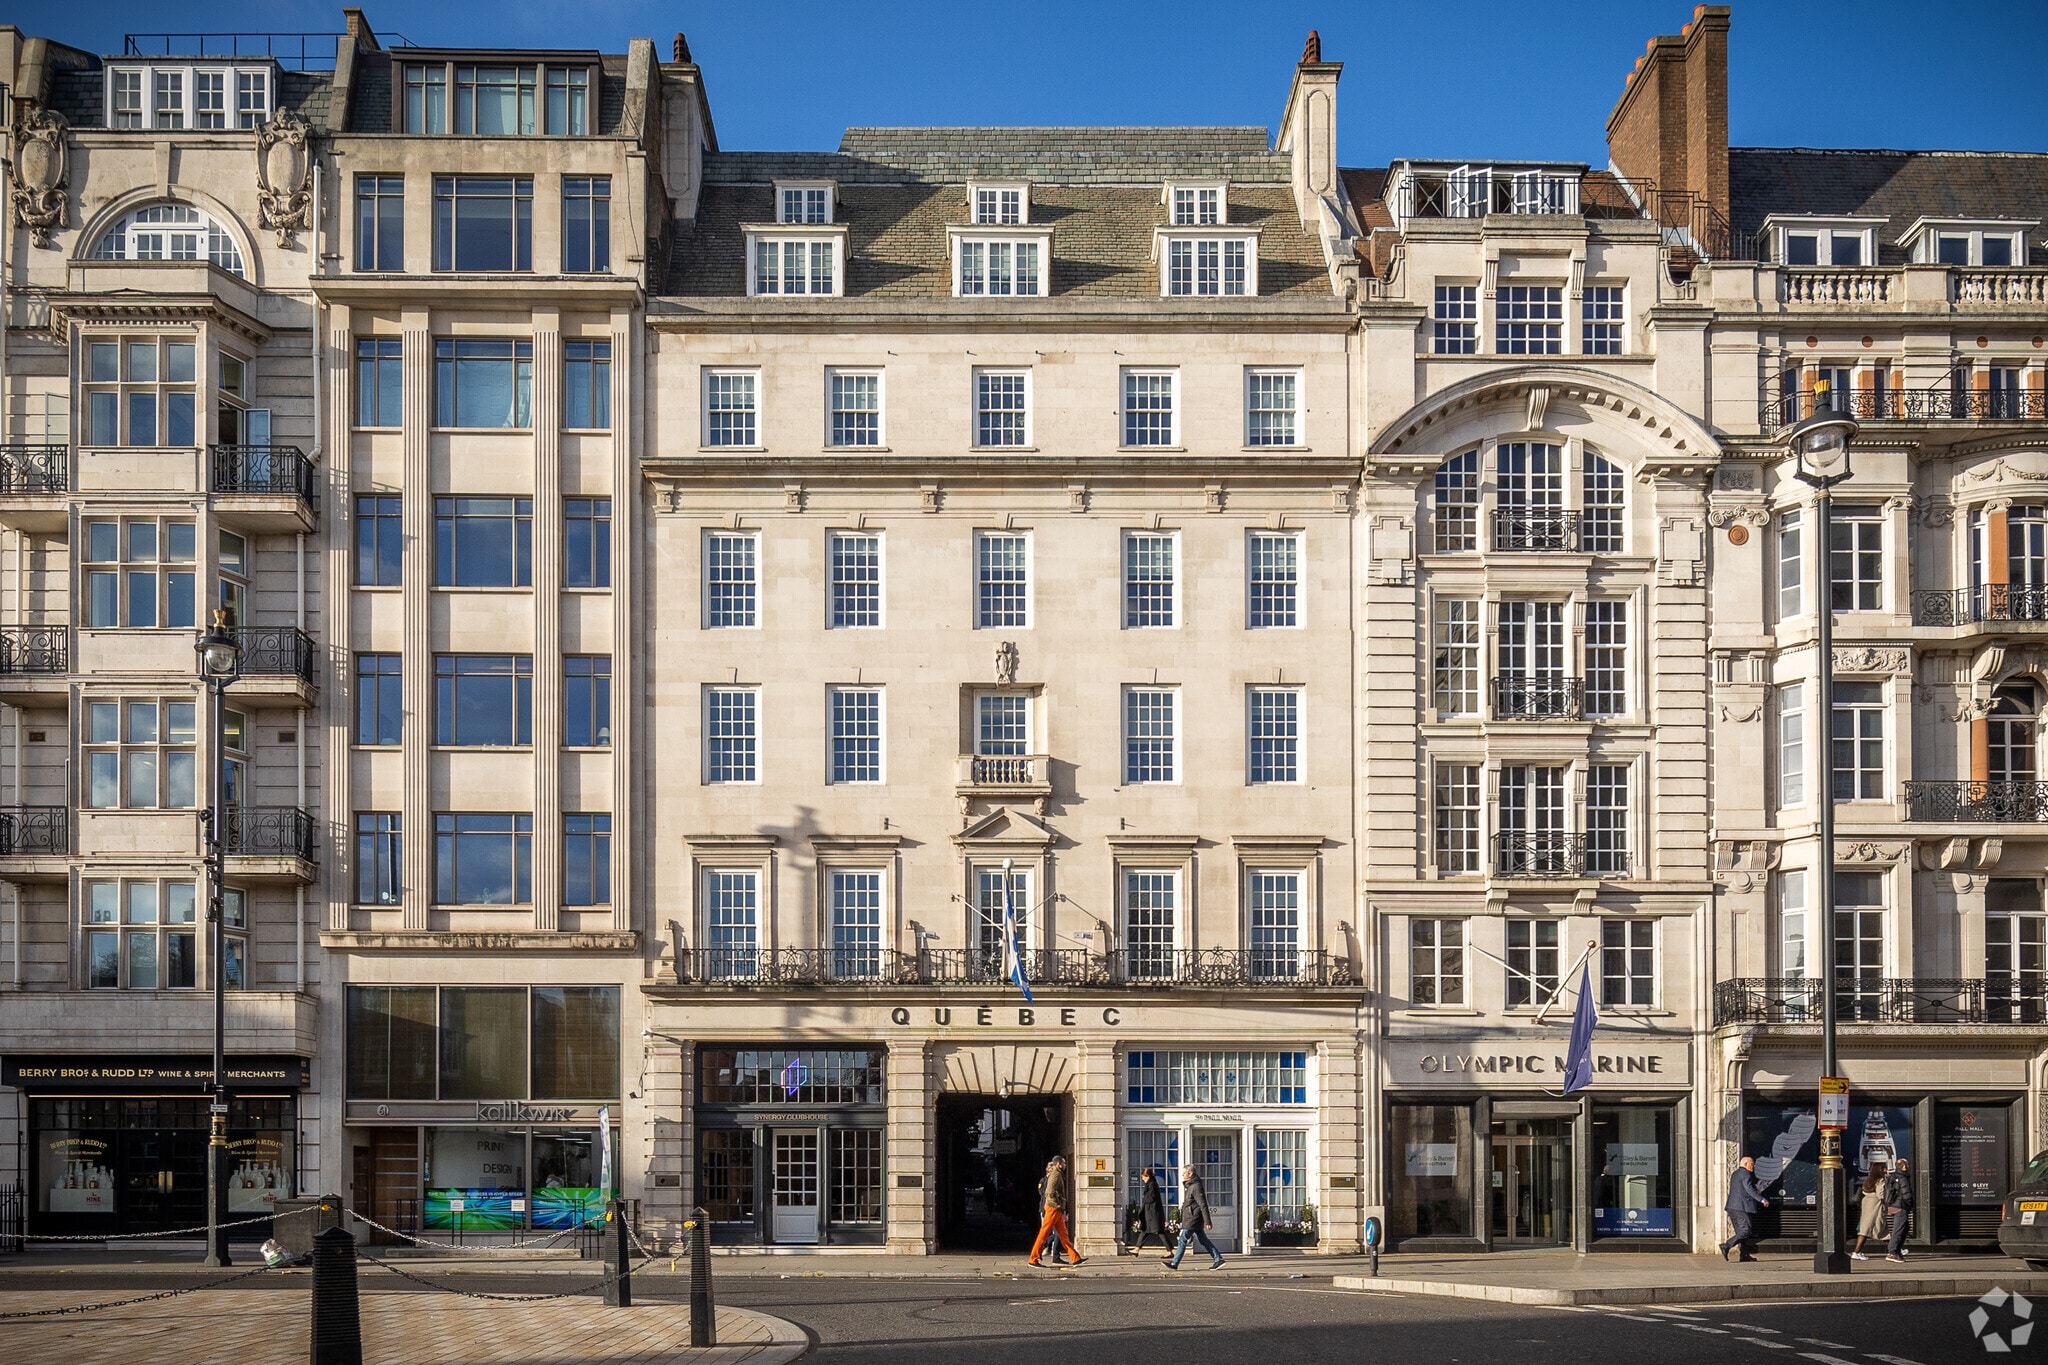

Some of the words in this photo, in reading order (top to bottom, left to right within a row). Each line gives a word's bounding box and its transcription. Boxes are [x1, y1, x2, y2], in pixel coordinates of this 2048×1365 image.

[891, 1004, 1121, 1026] QUÉBEC
[1420, 1055, 1545, 1073] OLYMPIC
[19, 1068, 57, 1077] BERRY
[91, 1068, 99, 1077] &
[102, 1068, 135, 1078] RUDD
[158, 1070, 182, 1078] WINE
[184, 1070, 191, 1078] &
[194, 1070, 226, 1078] SPIR
[227, 1070, 286, 1078] MERCHANTS
[477, 1141, 505, 1151] PRINT
[483, 1164, 513, 1174] DESIGN
